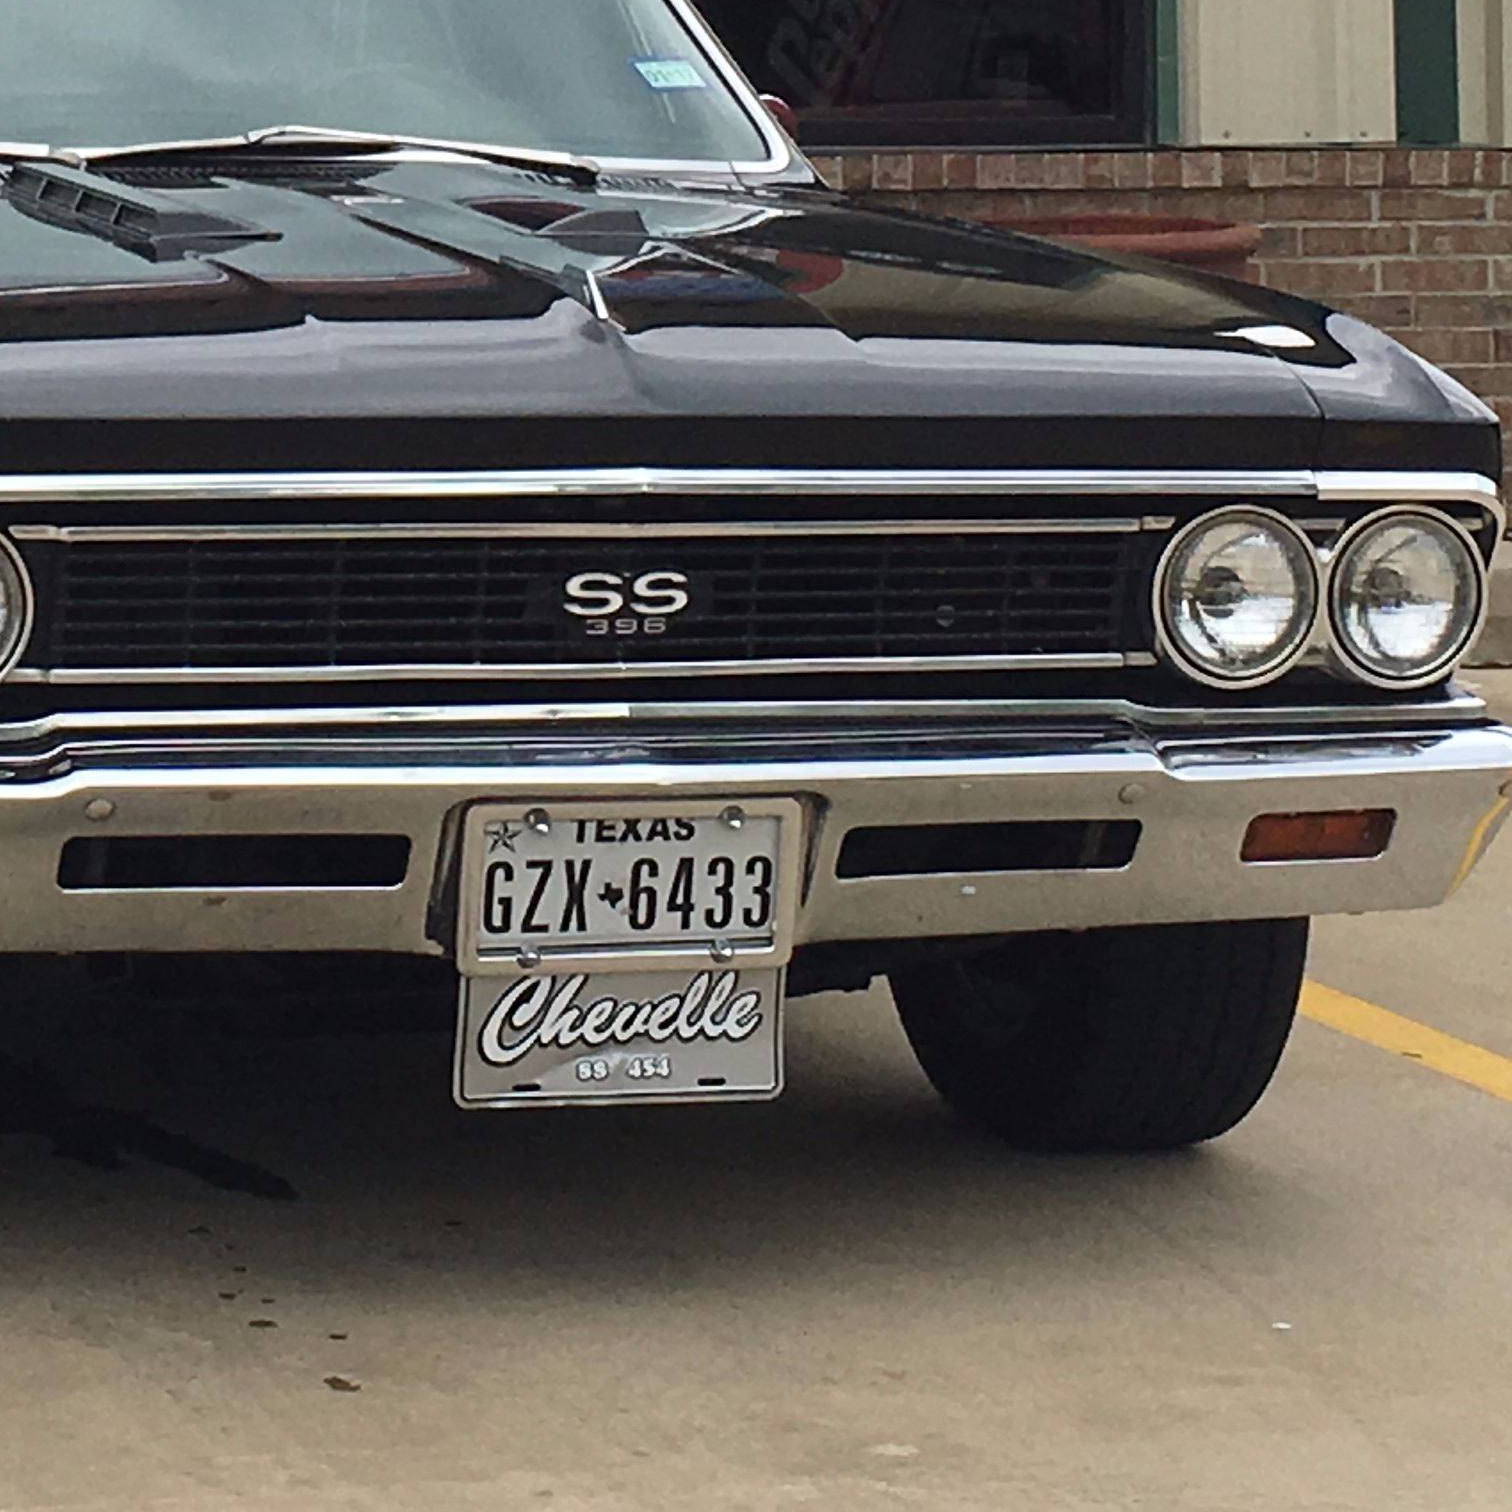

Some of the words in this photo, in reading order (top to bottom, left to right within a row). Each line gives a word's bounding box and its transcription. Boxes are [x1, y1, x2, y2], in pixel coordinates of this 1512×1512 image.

[563, 571, 688, 615] SS
[585, 618, 666, 635] 396
[574, 817, 696, 843] TEXAS
[483, 859, 592, 934] GZX
[628, 855, 773, 931] 6433
[478, 970, 762, 1067] Chevelle
[627, 1056, 671, 1080] 454
